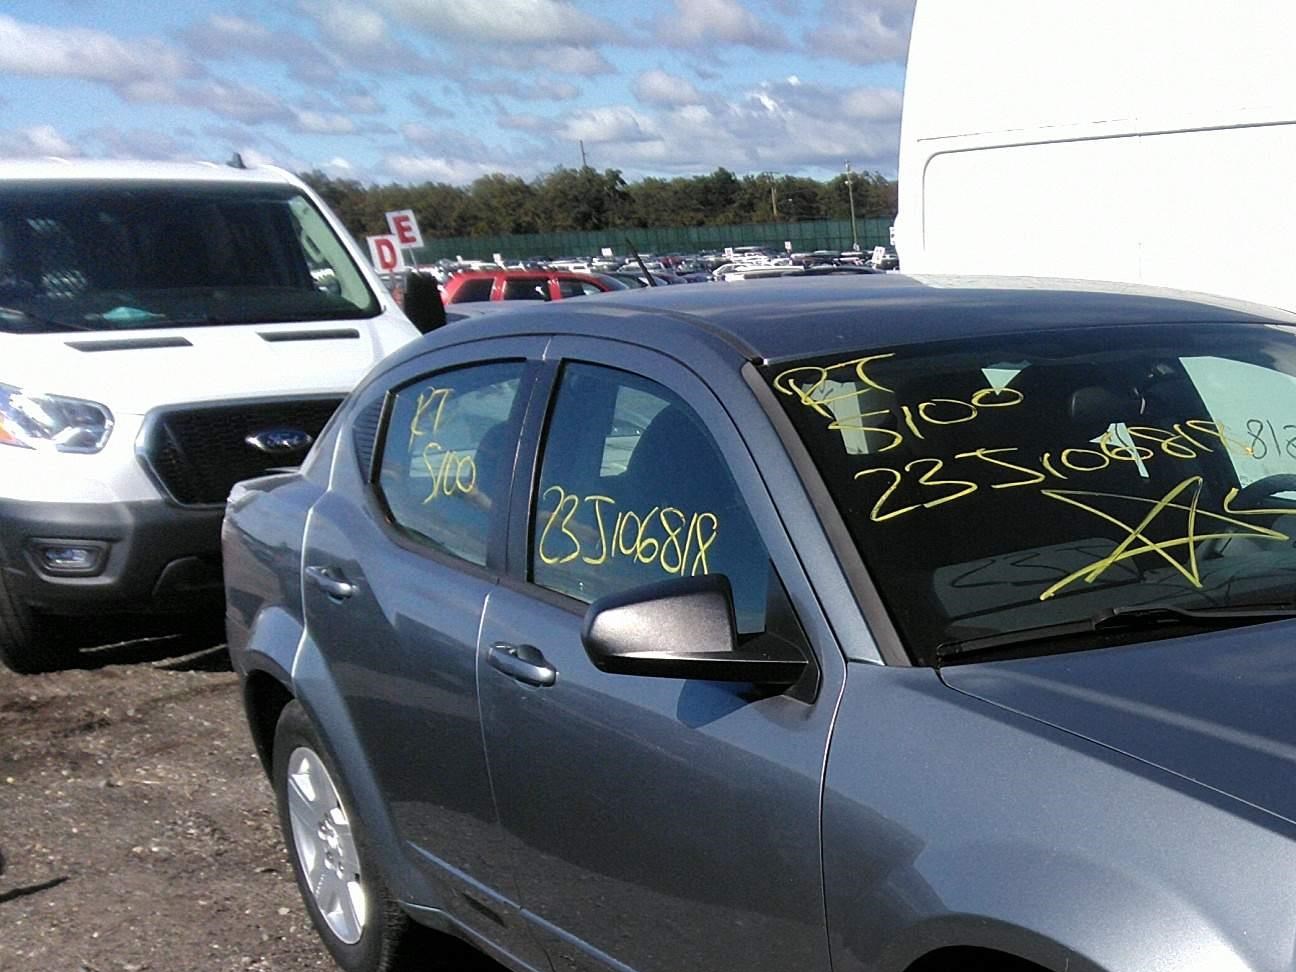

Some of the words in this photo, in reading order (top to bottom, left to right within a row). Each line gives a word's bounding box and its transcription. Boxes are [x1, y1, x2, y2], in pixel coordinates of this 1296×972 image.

[392, 214, 418, 244] E
[373, 238, 398, 270] D
[774, 352, 896, 419] RT
[539, 485, 718, 577] 23J106818
